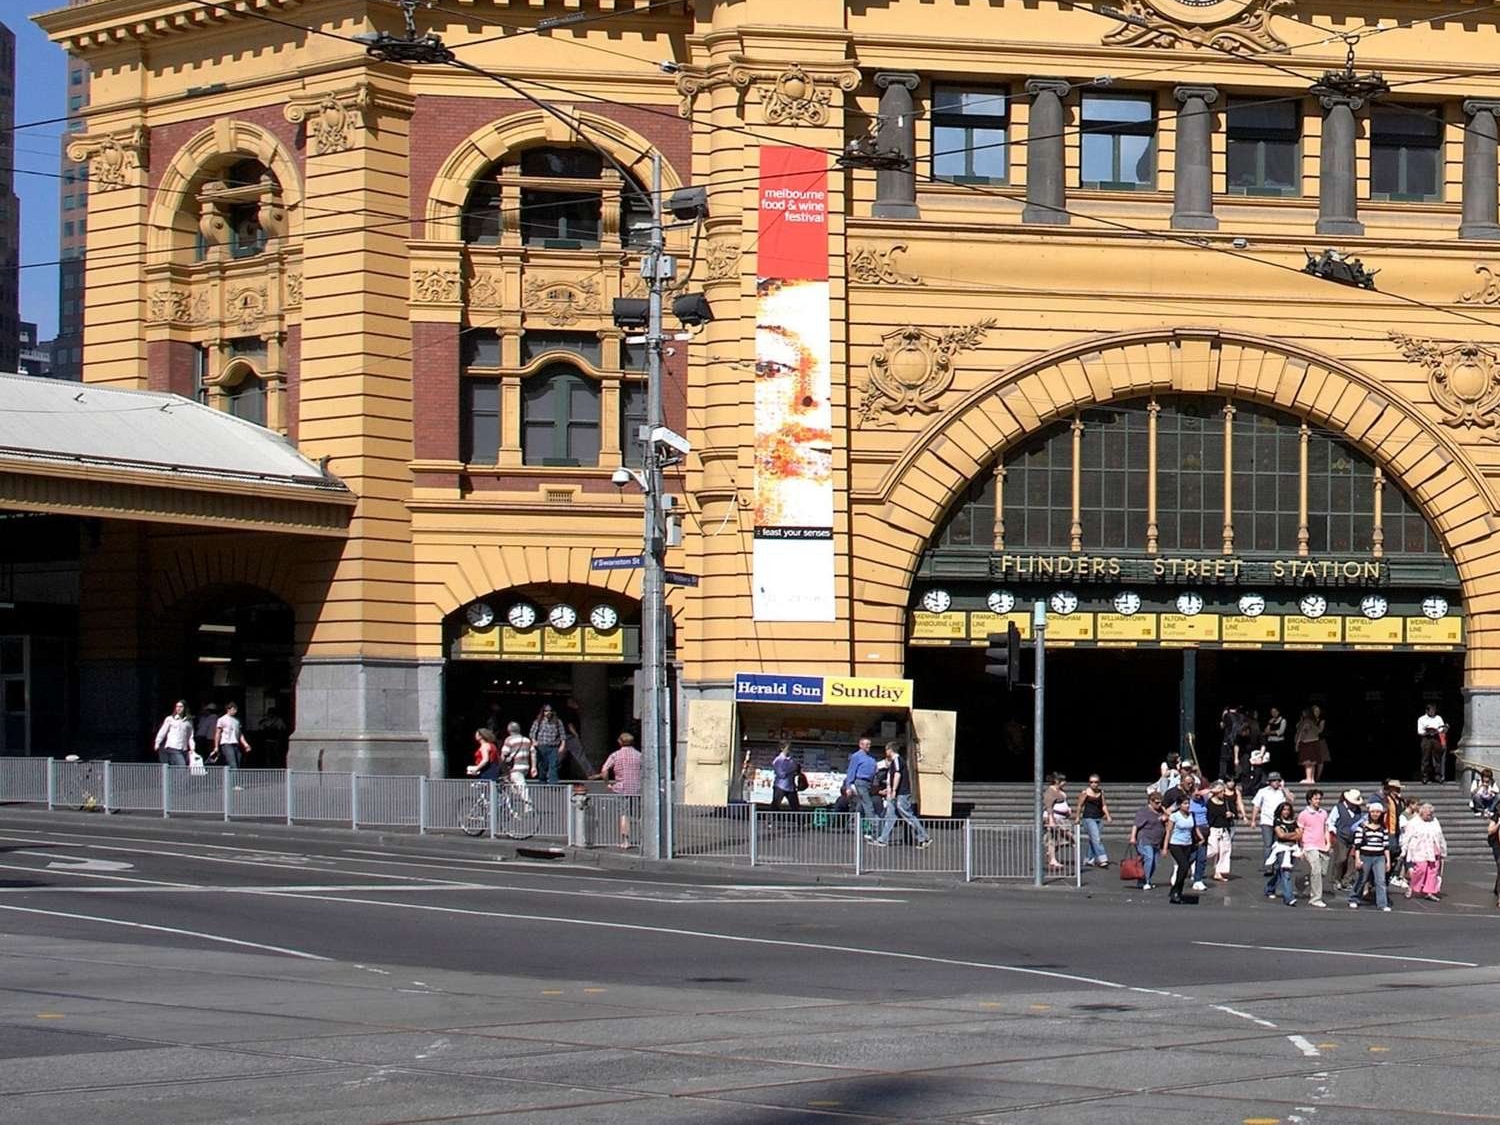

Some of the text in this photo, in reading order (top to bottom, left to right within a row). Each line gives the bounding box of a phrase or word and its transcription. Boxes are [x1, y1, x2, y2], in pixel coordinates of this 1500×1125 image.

[765, 189, 824, 199] melbourne
[761, 200, 824, 212] food & wine
[784, 211, 824, 223] festival
[762, 528, 781, 536] feast
[783, 529, 801, 537] your
[598, 559, 631, 567] Swanston
[1002, 556, 1380, 578] FLINDERS STREET STATION
[737, 682, 821, 696] Herald Sun
[831, 683, 904, 702] Sunday
